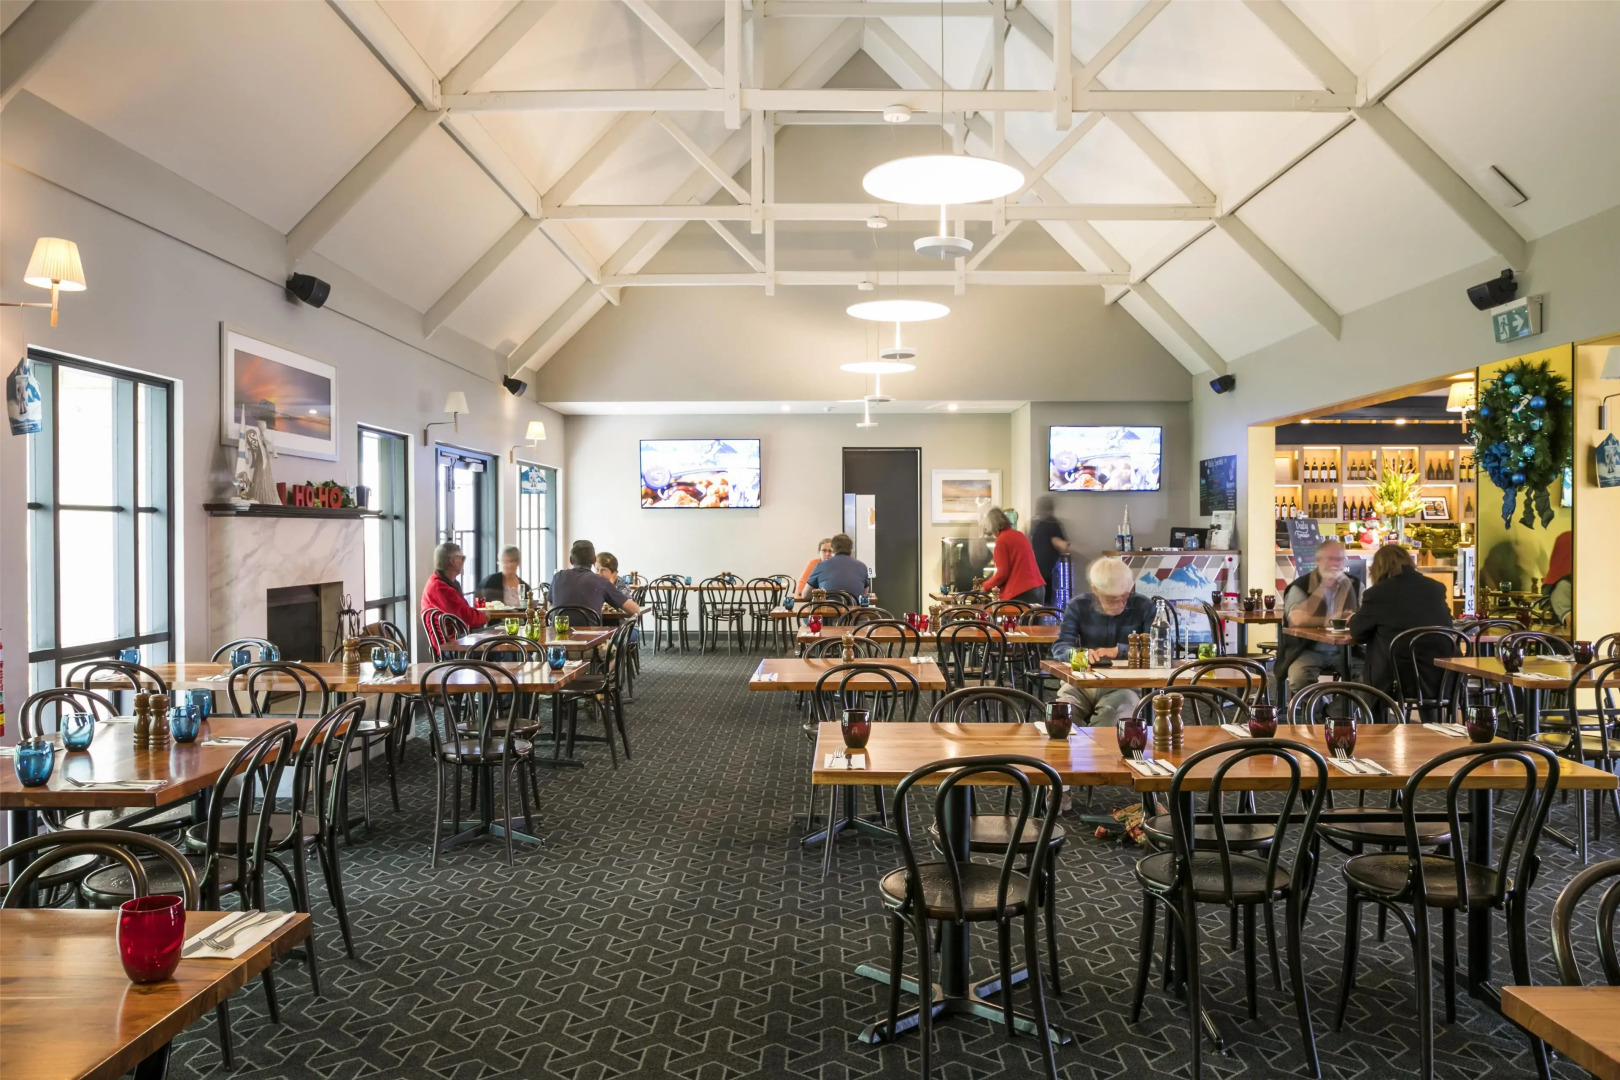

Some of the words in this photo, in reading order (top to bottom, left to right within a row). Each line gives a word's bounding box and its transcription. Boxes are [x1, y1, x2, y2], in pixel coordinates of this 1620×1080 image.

[294, 485, 314, 508] HO
[318, 486, 342, 509] HO
[1295, 520, 1309, 532] Daily
